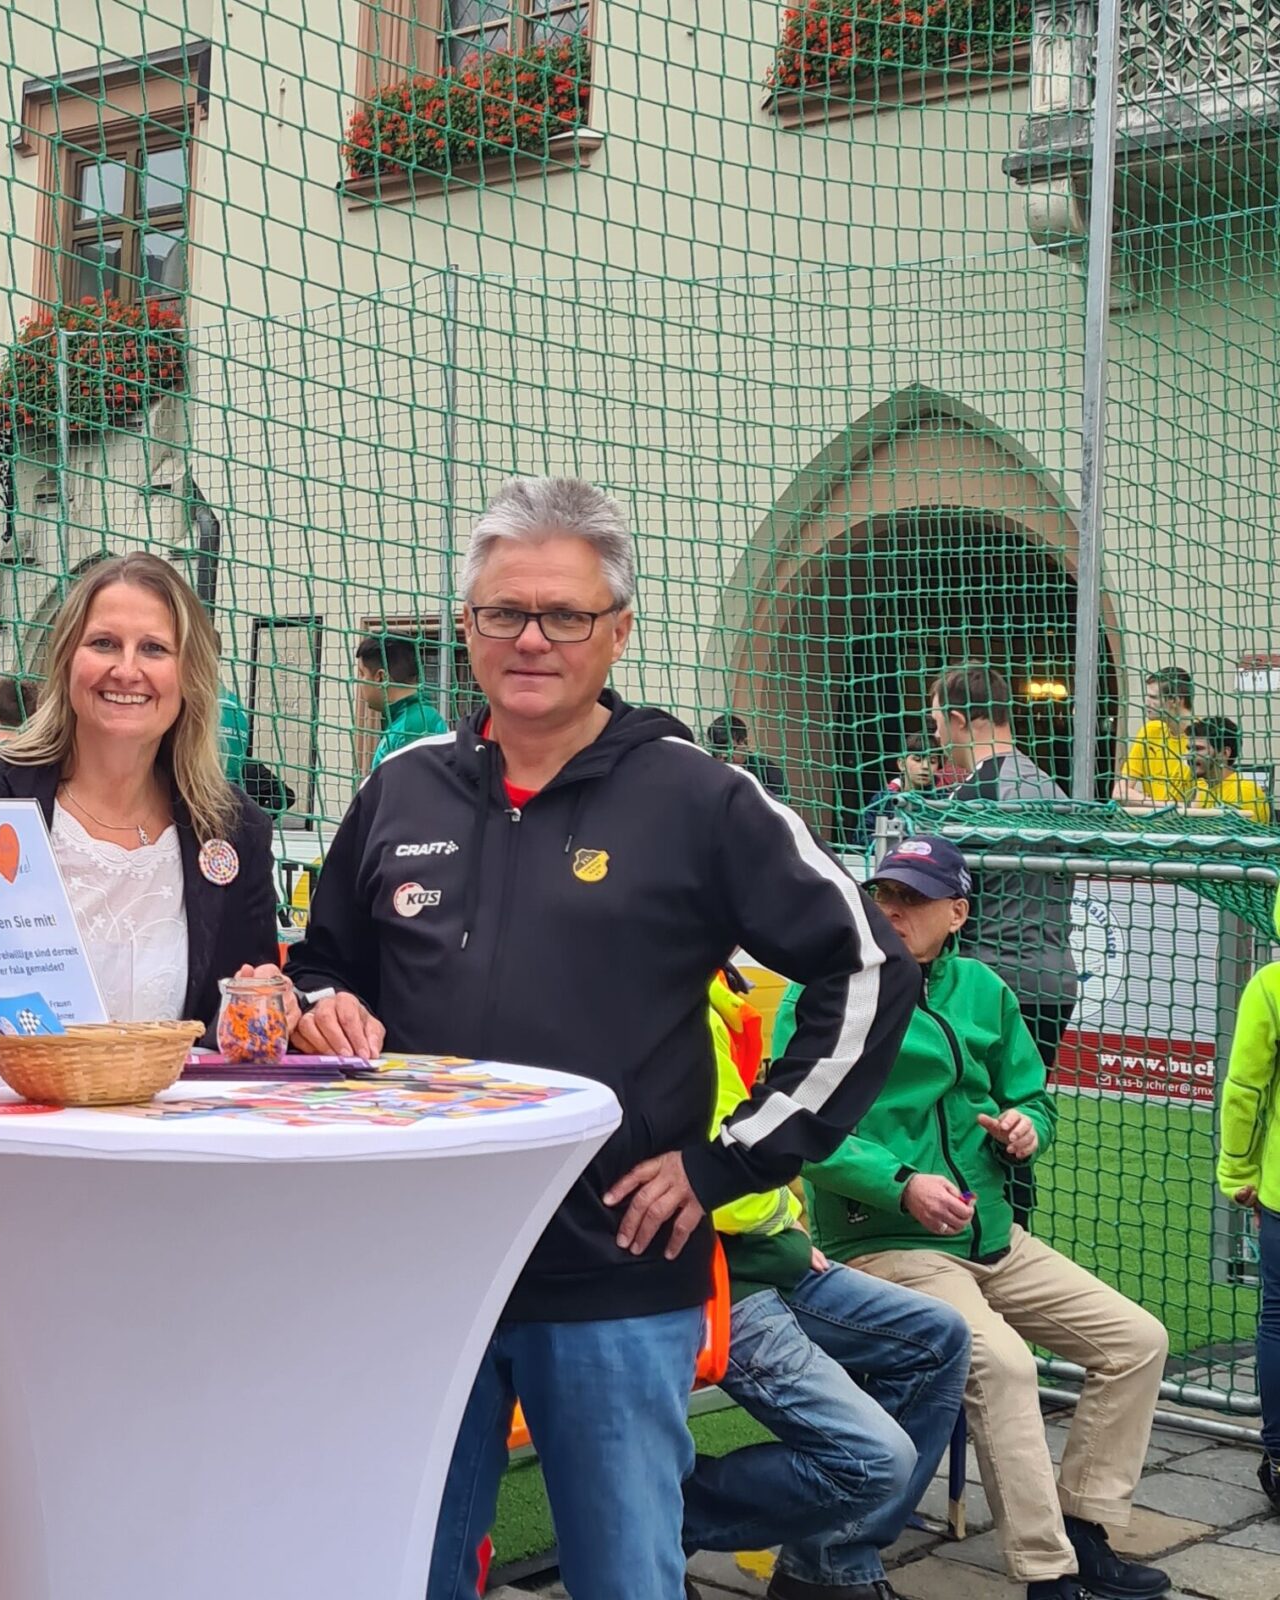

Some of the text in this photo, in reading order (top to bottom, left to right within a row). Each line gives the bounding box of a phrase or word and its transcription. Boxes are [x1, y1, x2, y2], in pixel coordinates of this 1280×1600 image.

[395, 841, 447, 857] CRAFT
[13, 914, 33, 929] Sie
[33, 912, 57, 928] mit!
[34, 947, 52, 958] sind
[51, 945, 80, 957] derzeit
[9, 964, 25, 975] fala
[25, 961, 66, 976] gemeldet?
